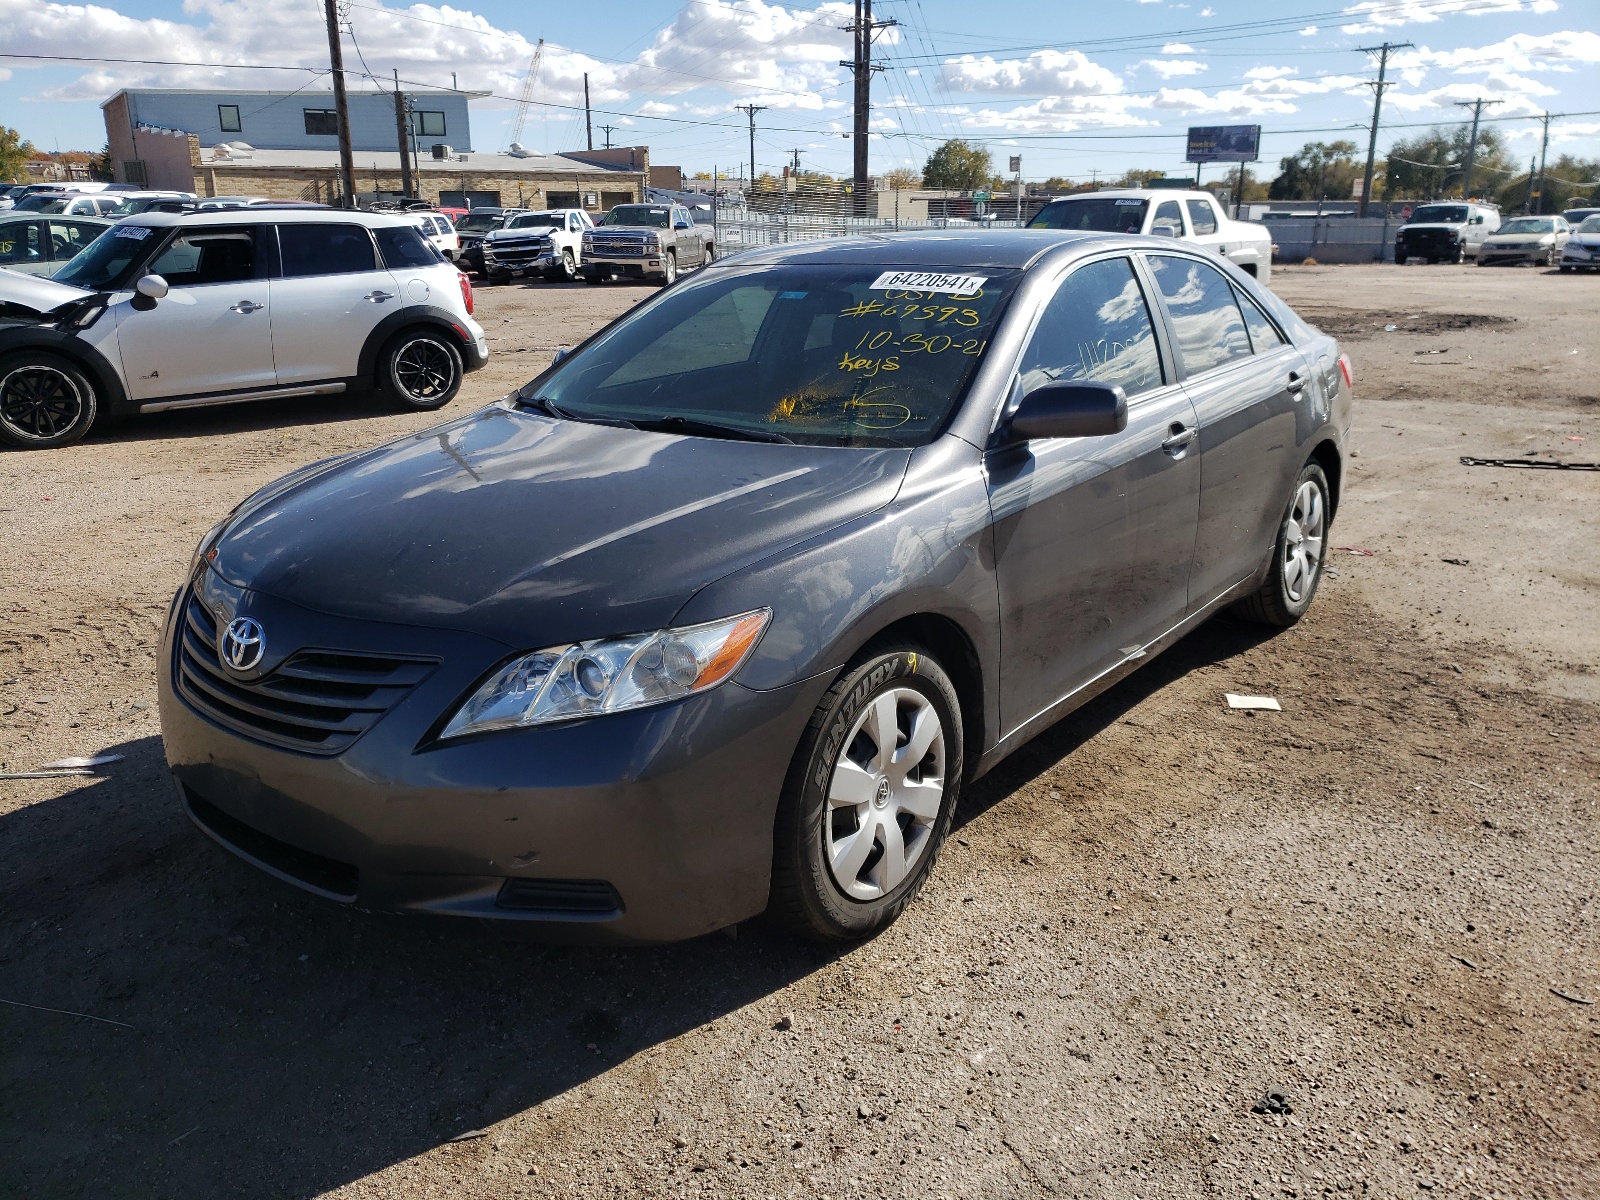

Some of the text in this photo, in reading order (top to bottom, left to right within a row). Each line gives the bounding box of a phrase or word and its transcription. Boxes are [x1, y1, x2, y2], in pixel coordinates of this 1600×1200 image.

[888, 272, 970, 290] 64220541
[855, 330, 987, 357] 10-30-21
[814, 657, 899, 789] SENTURY
